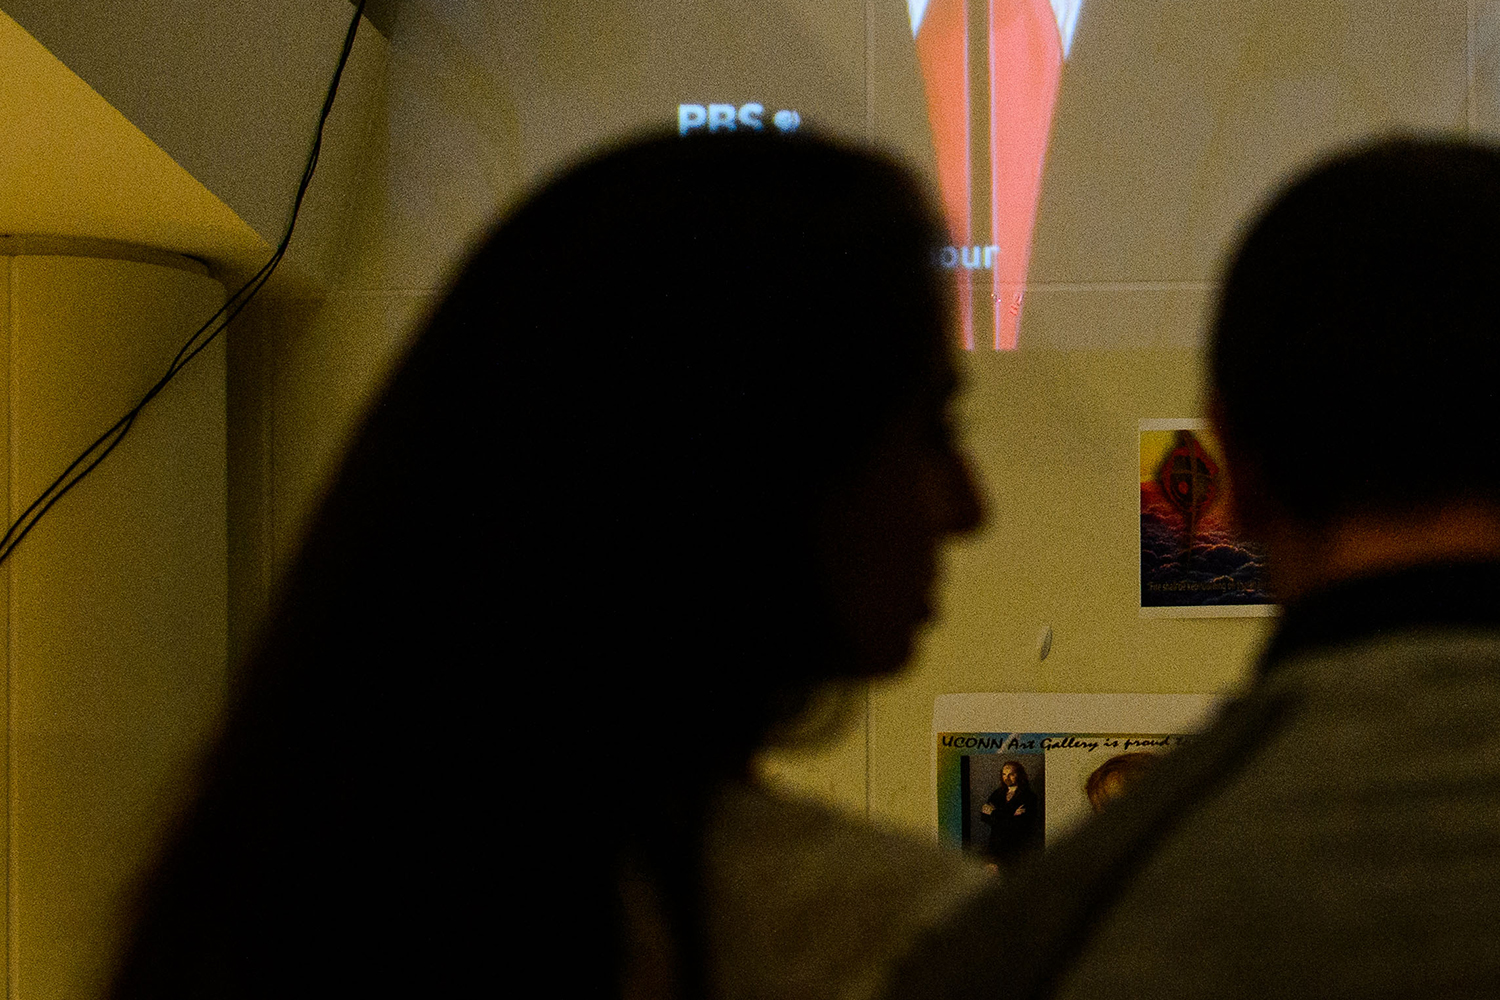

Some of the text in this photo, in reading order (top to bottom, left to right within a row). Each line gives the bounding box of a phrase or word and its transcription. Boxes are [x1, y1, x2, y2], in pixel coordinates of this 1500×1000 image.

[677, 102, 765, 136] PBS
[941, 735, 1003, 749] UCONN
[1008, 737, 1036, 750] Art
[1040, 736, 1101, 752] Gallery
[1103, 737, 1119, 748] is
[1124, 735, 1171, 750] proud
